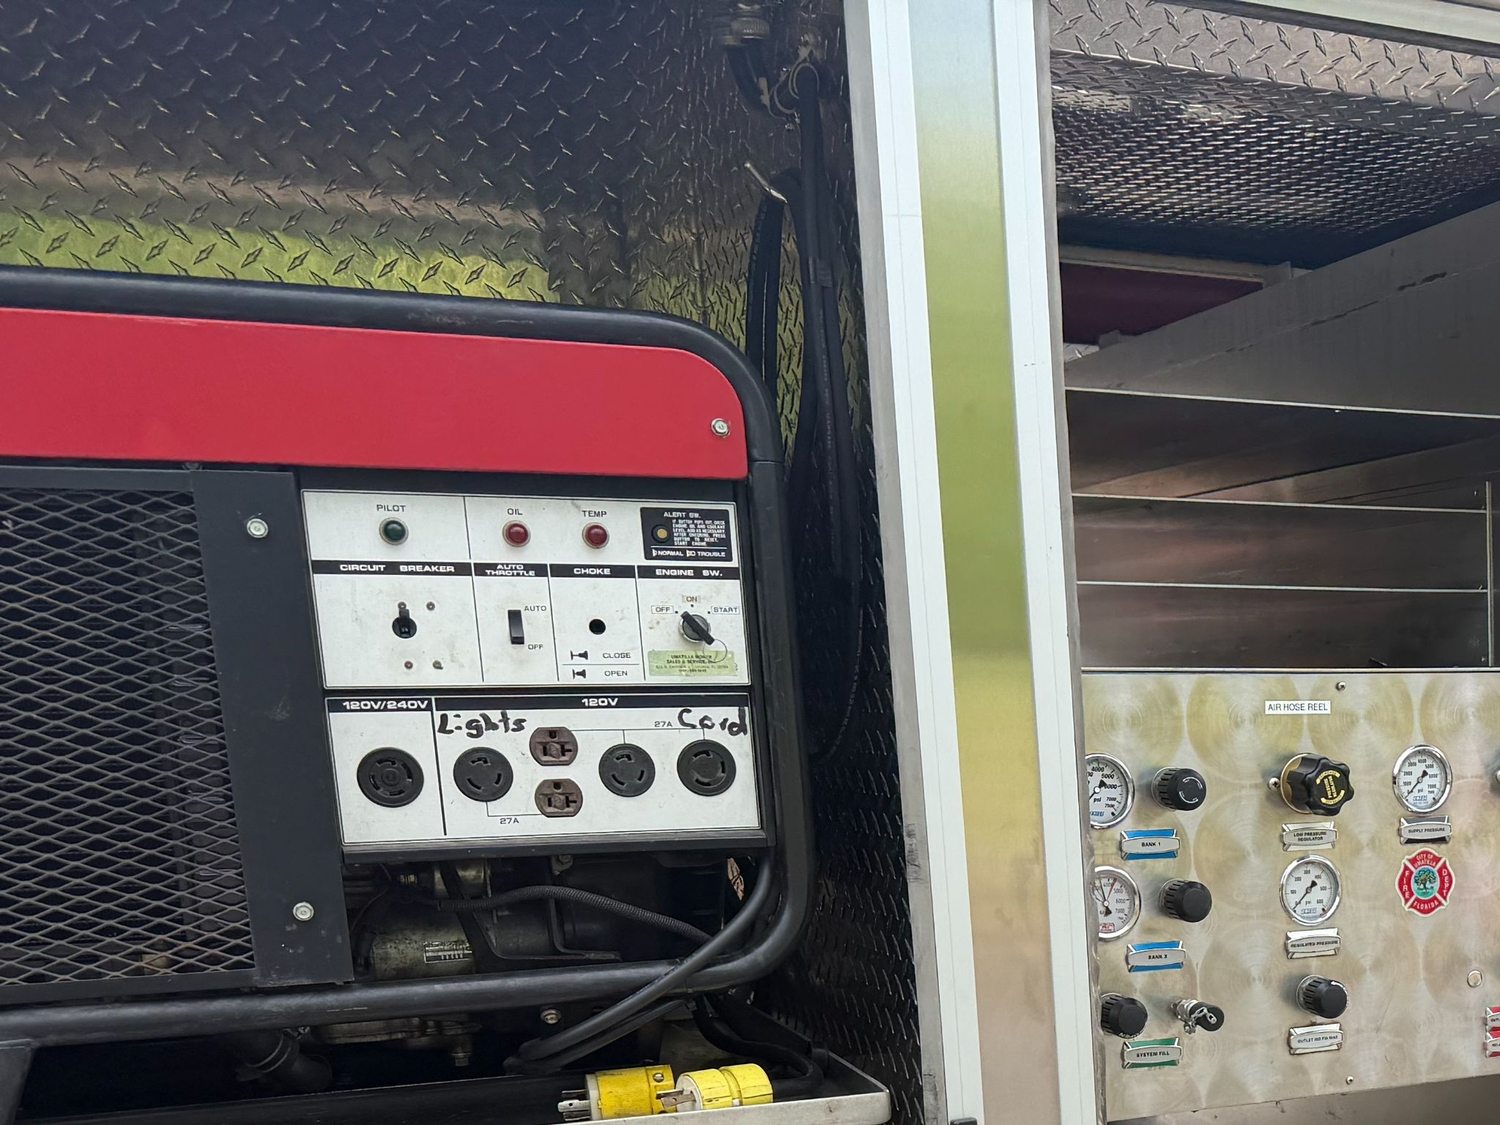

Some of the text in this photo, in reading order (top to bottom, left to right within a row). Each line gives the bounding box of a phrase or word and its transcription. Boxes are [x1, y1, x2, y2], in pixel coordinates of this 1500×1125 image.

[376, 504, 406, 512] PILOT
[507, 508, 523, 516] OIL
[582, 510, 607, 518] TEMP
[339, 564, 455, 573] CIRCUIT BREAKER
[573, 567, 611, 575] CHOKE
[342, 699, 429, 710] 120V/240V
[581, 697, 619, 707] 120V
[1267, 702, 1328, 712] AIR HOSE REEL
[436, 711, 527, 739] Lights
[653, 720, 673, 728] 27A
[677, 707, 748, 737] Cord
[499, 817, 520, 825] 27A
[1415, 853, 1427, 861] CITY
[1413, 858, 1437, 868] UMATILLA
[1402, 870, 1410, 899] FIRE
[1441, 868, 1450, 897] DEPT
[1412, 899, 1440, 910] FLORIDA
[1136, 1051, 1158, 1059] SYSTEM
